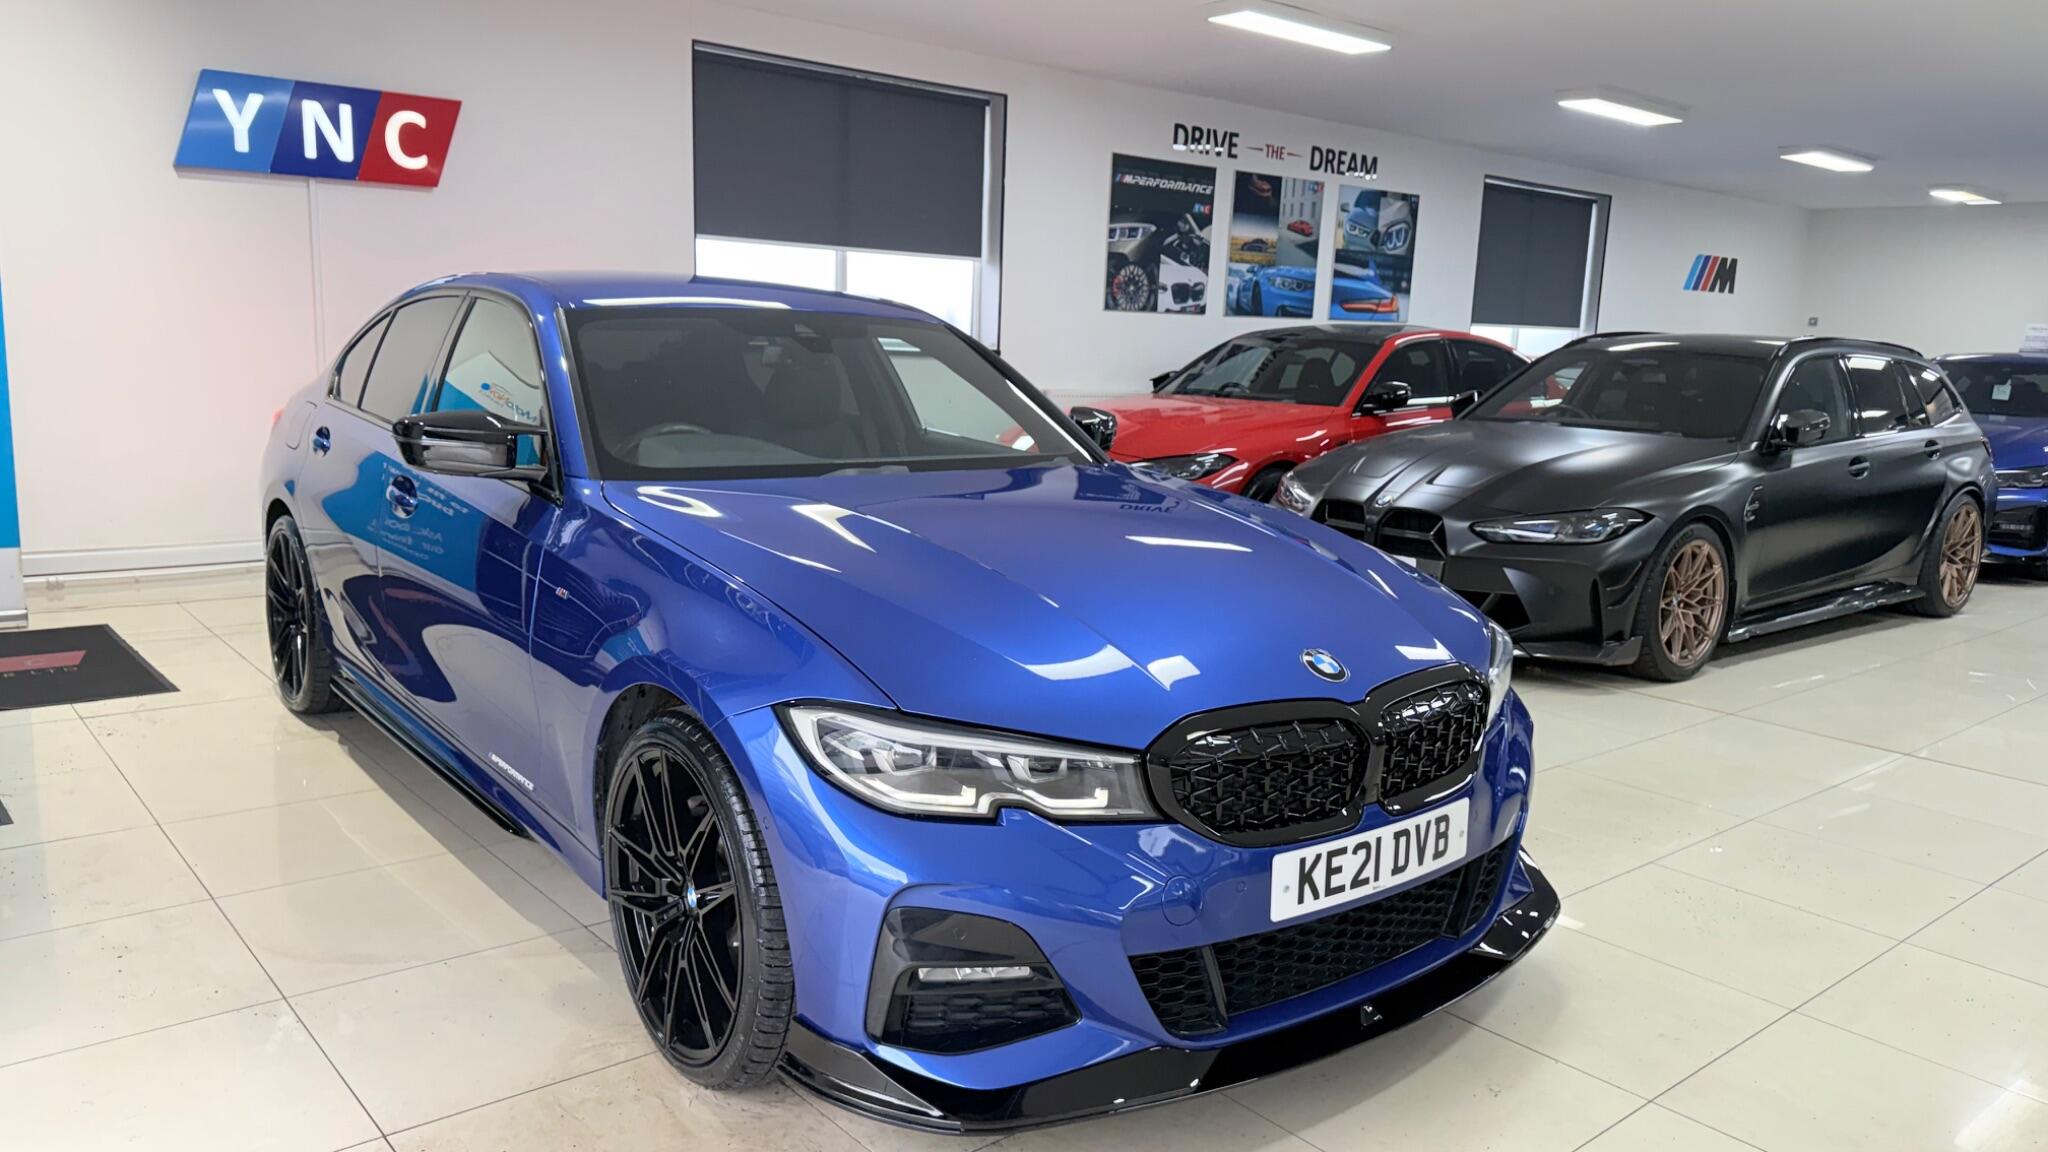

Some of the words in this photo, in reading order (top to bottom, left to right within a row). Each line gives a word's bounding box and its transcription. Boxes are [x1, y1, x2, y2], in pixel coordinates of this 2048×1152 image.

[212, 89, 428, 171] YNC
[1173, 123, 1240, 159] DRIVE
[1265, 144, 1286, 161] THE
[1310, 145, 1378, 180] DREAM
[1297, 837, 1382, 905] KE21
[1391, 814, 1450, 877] DVB
